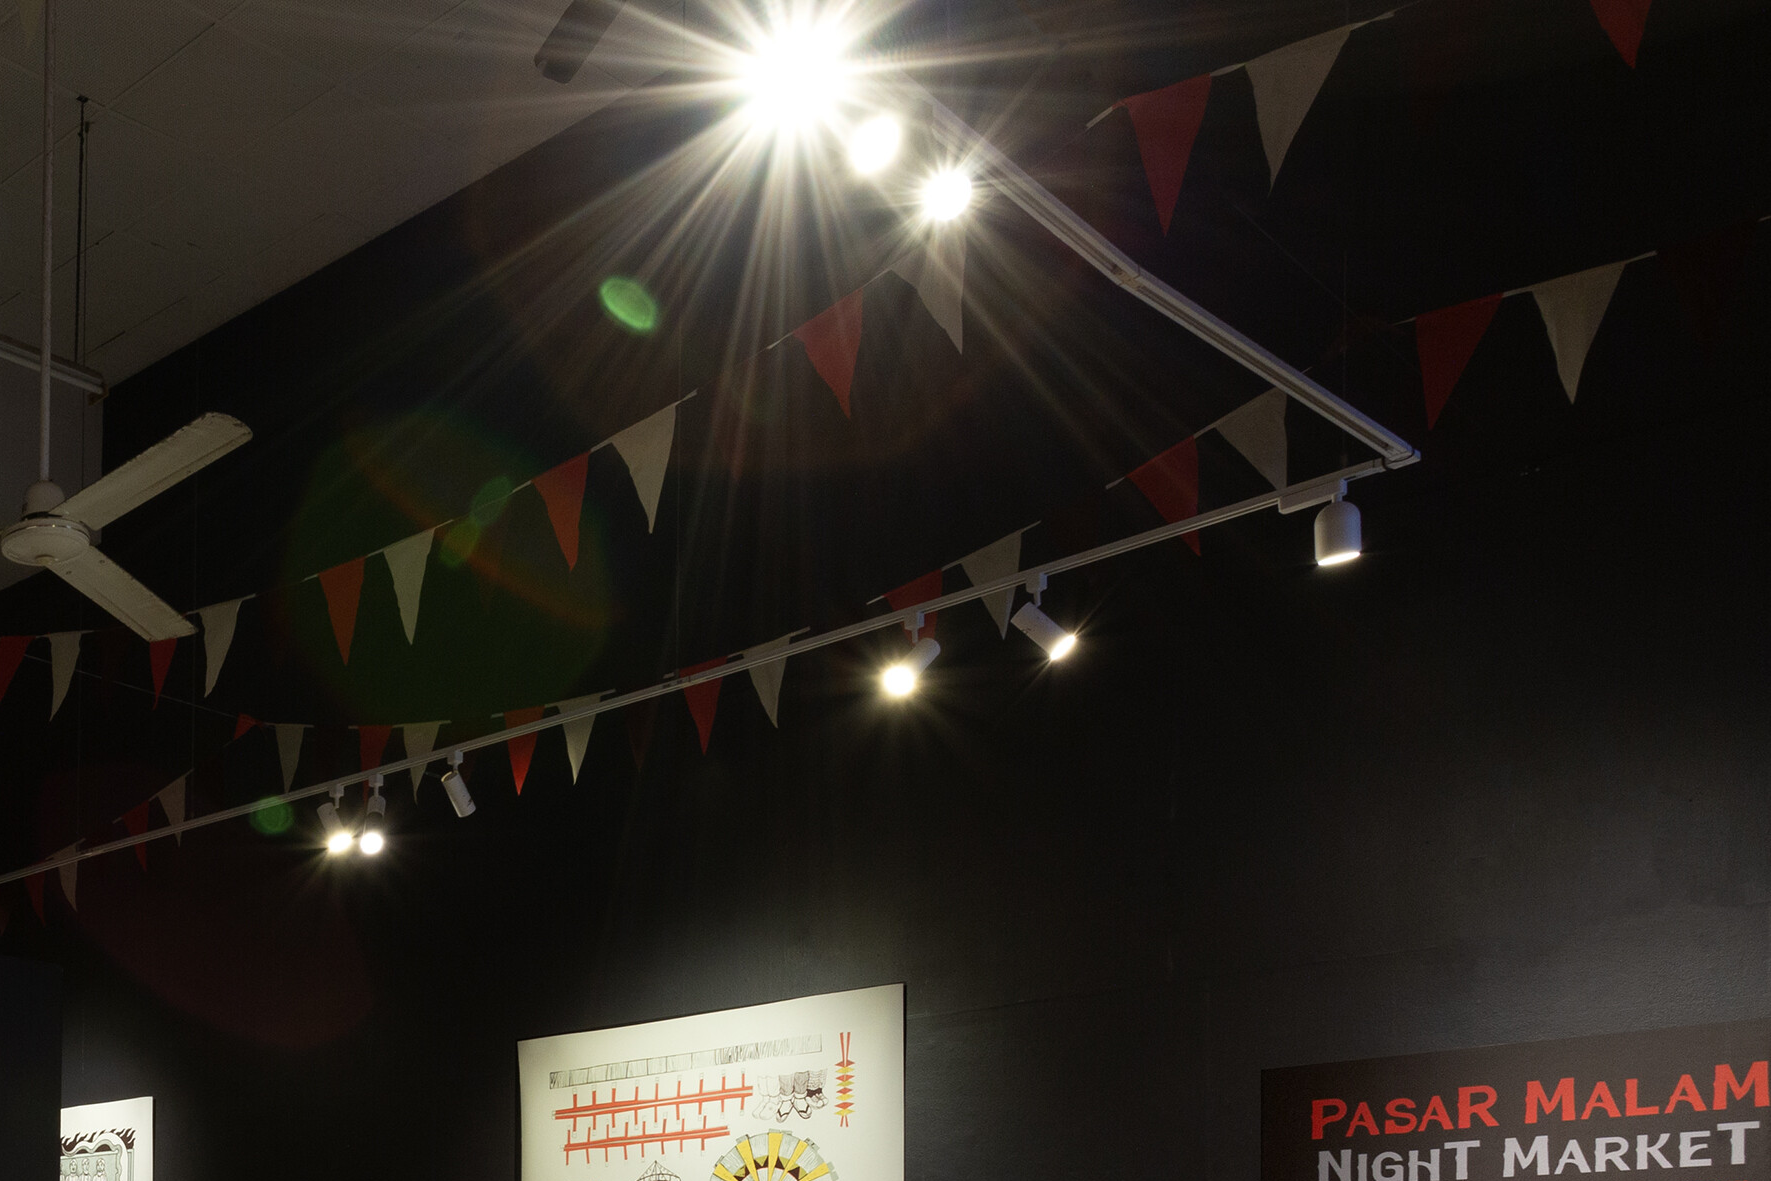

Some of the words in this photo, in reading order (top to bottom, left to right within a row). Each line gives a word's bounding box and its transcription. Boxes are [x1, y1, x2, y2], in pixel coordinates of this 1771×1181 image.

[1311, 1085, 1499, 1139] PASAR
[1525, 1060, 1770, 1123] MALAM
[1502, 1120, 1761, 1178] MARKET
